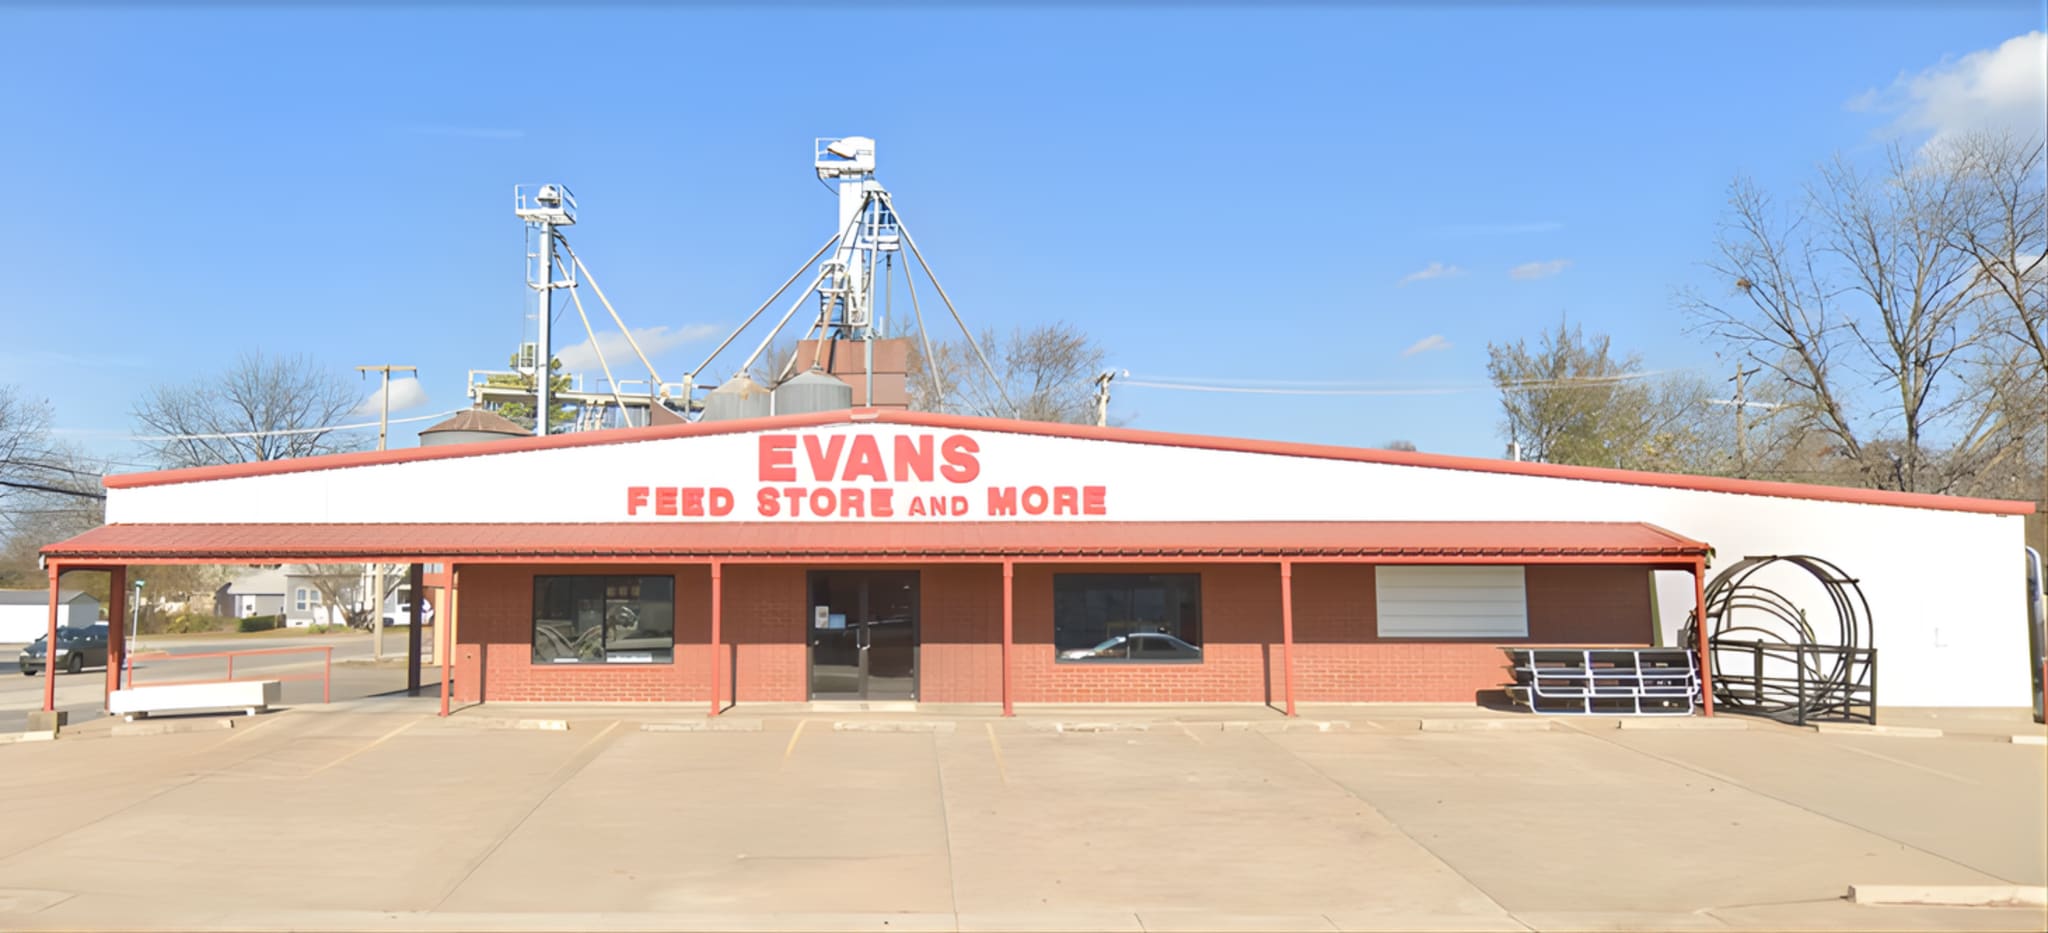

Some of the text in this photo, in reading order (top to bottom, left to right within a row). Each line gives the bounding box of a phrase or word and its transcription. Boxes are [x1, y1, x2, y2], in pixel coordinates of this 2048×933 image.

[758, 434, 980, 484] EVANS
[627, 485, 1107, 518] FEED STORE AND MORE
